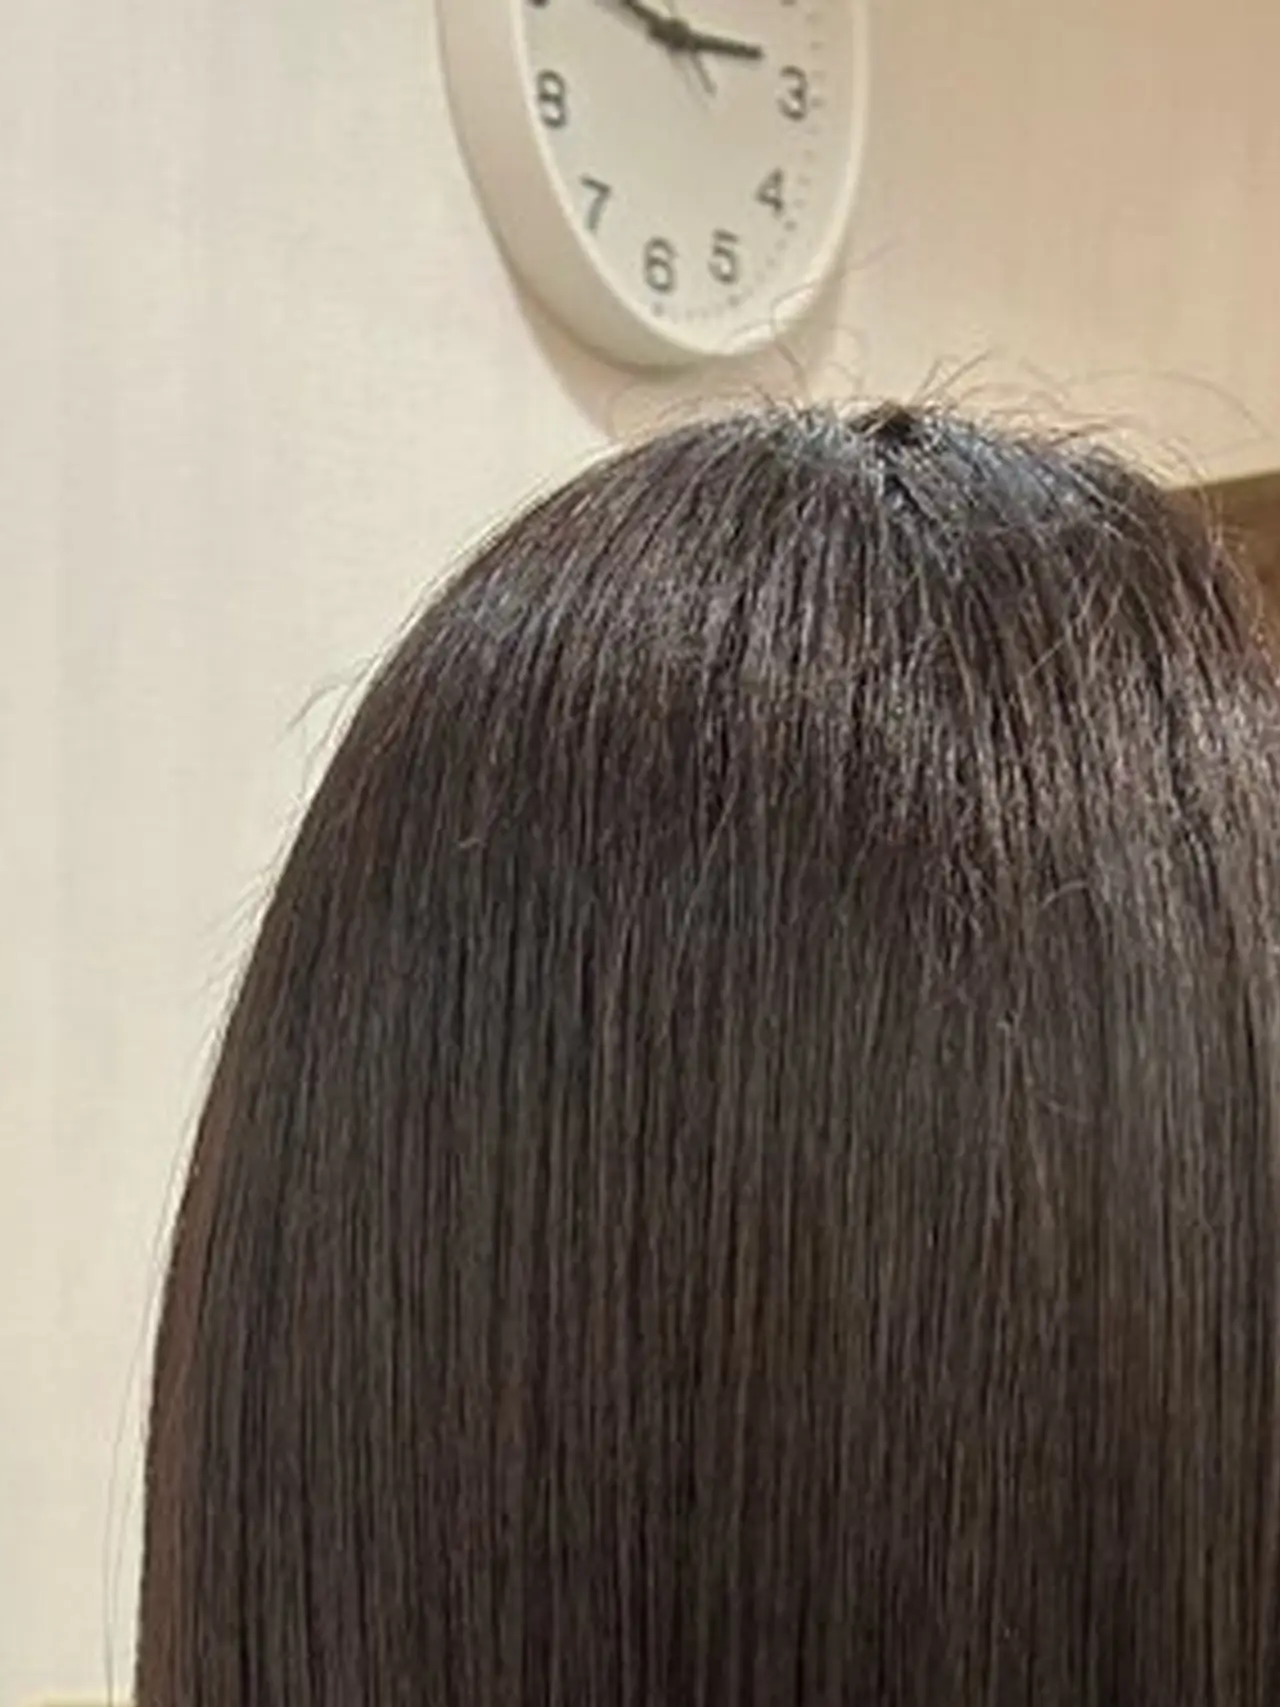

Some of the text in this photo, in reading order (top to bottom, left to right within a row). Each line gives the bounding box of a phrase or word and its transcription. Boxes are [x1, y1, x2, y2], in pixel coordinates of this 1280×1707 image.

[536, 69, 568, 129] 8
[778, 65, 810, 121] 3
[580, 176, 612, 234] 7
[755, 168, 785, 216] 4
[643, 236, 678, 293] 6
[707, 228, 740, 285] 5
